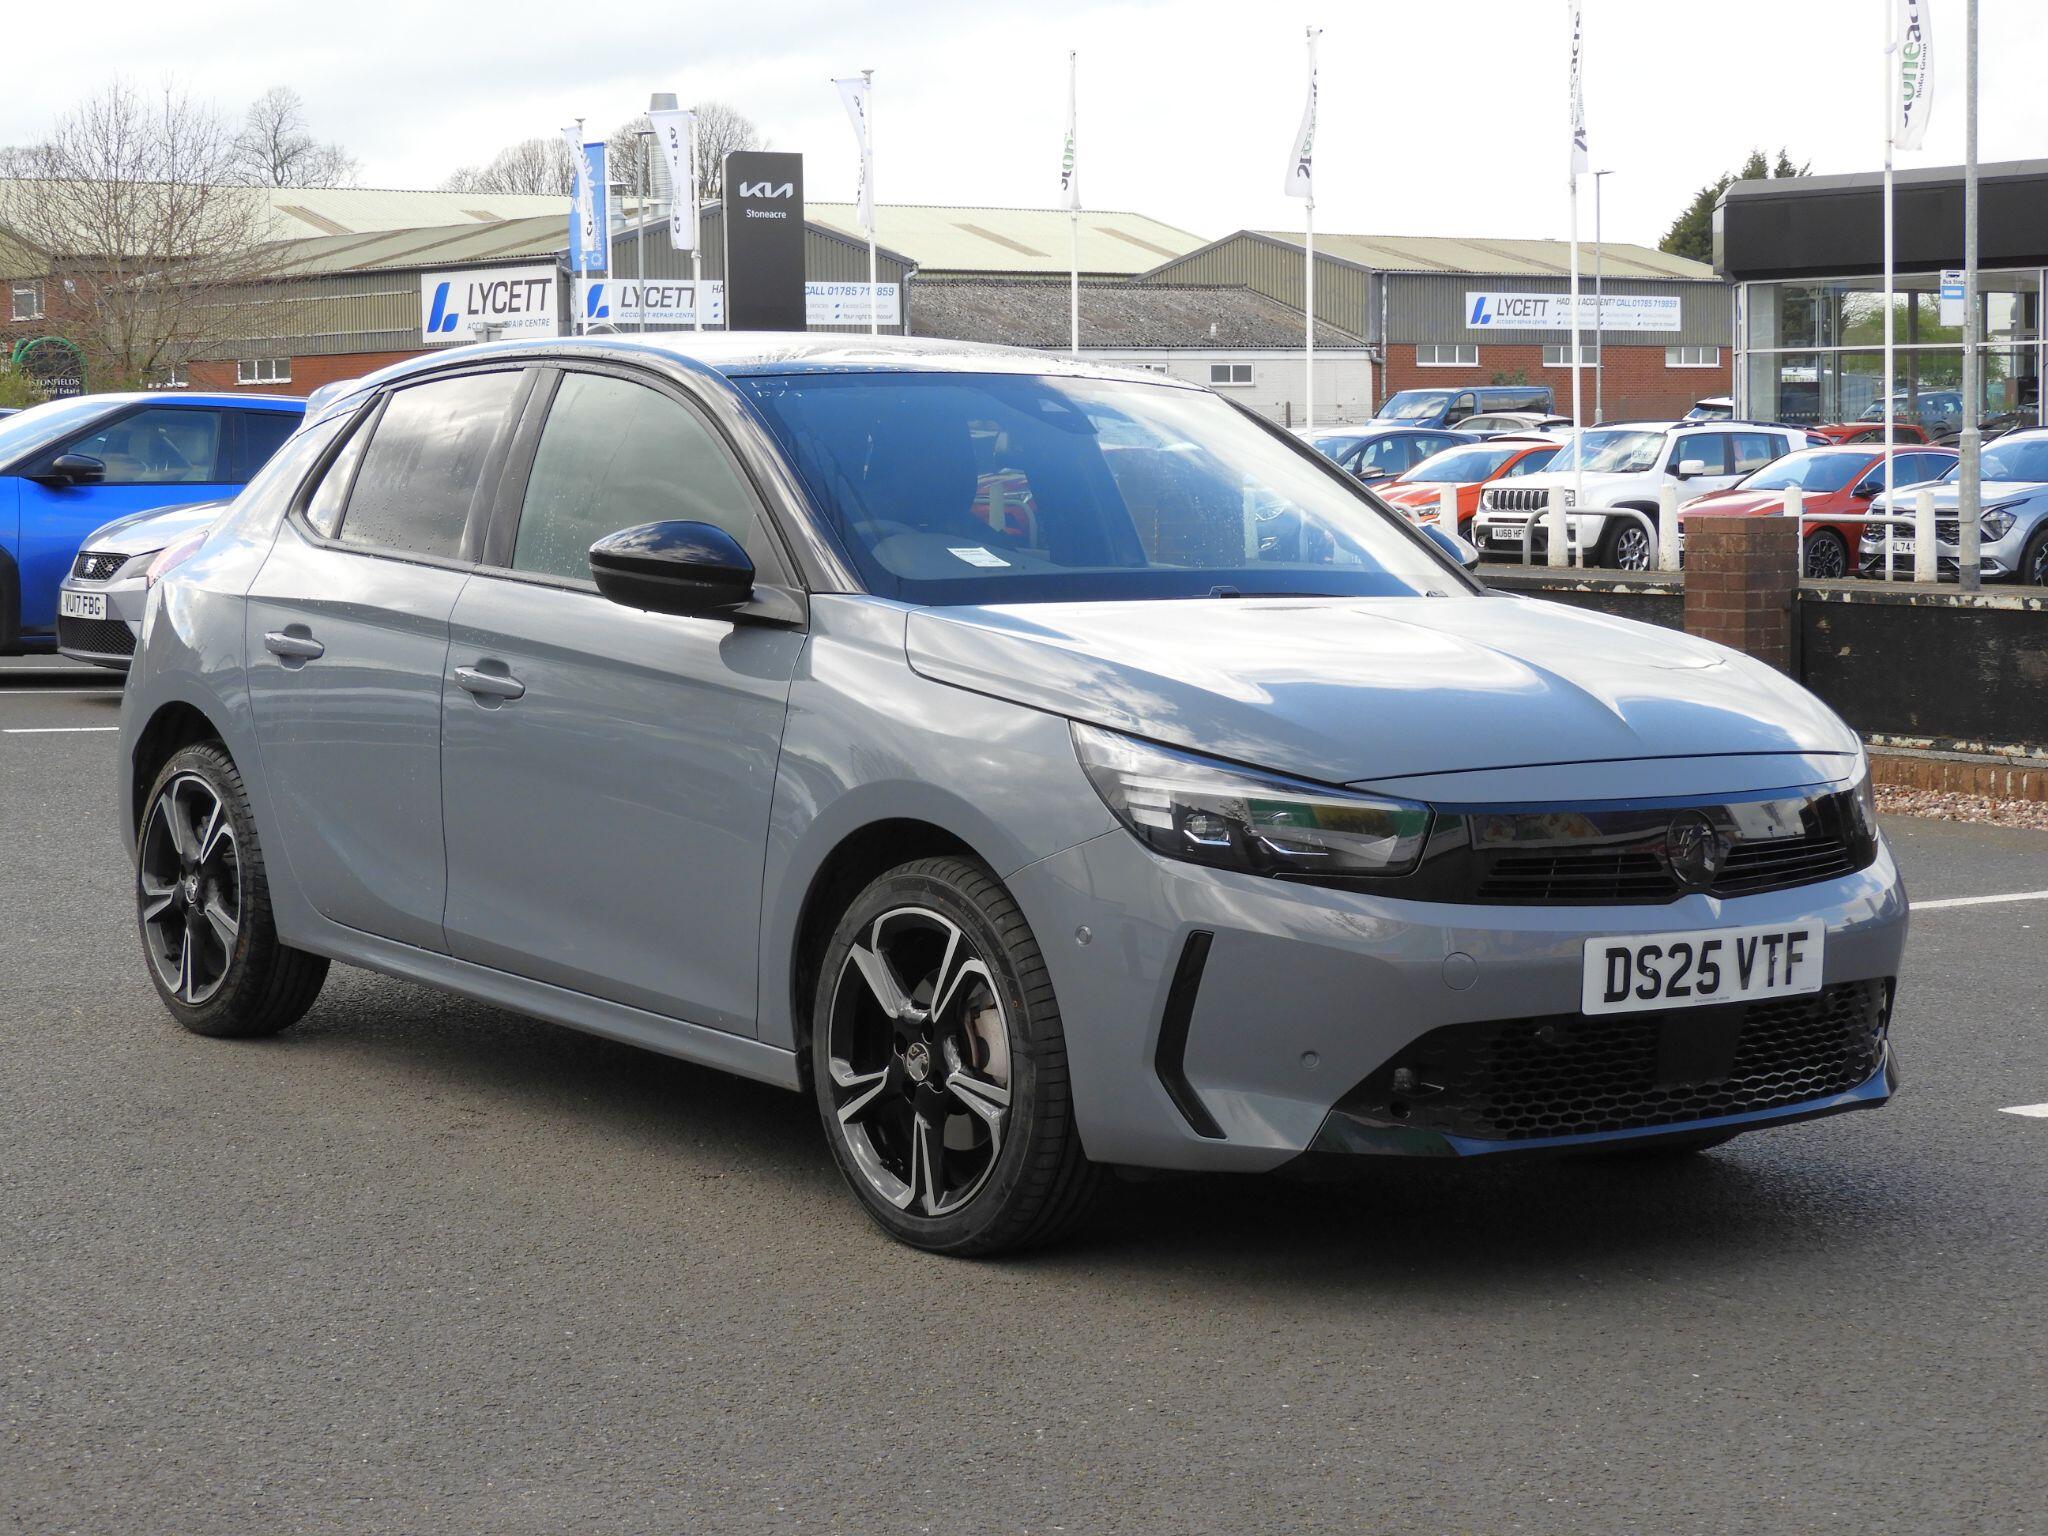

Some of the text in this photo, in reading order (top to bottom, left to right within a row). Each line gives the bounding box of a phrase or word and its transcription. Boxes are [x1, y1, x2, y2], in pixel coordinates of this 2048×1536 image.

[739, 181, 794, 199] KIA
[745, 209, 787, 219] Stoneacre
[467, 277, 553, 315] LYCETT
[620, 284, 895, 308] LYCETT HA CALL 01785 71859
[1496, 298, 1550, 317] LYCETT
[1616, 299, 1631, 307] CALL
[525, 318, 550, 328] CENTRE
[59, 387, 80, 395] Estate
[1513, 529, 1525, 538] HF
[82, 595, 101, 616] FBG
[1603, 930, 1809, 1003] DS25 VTF
